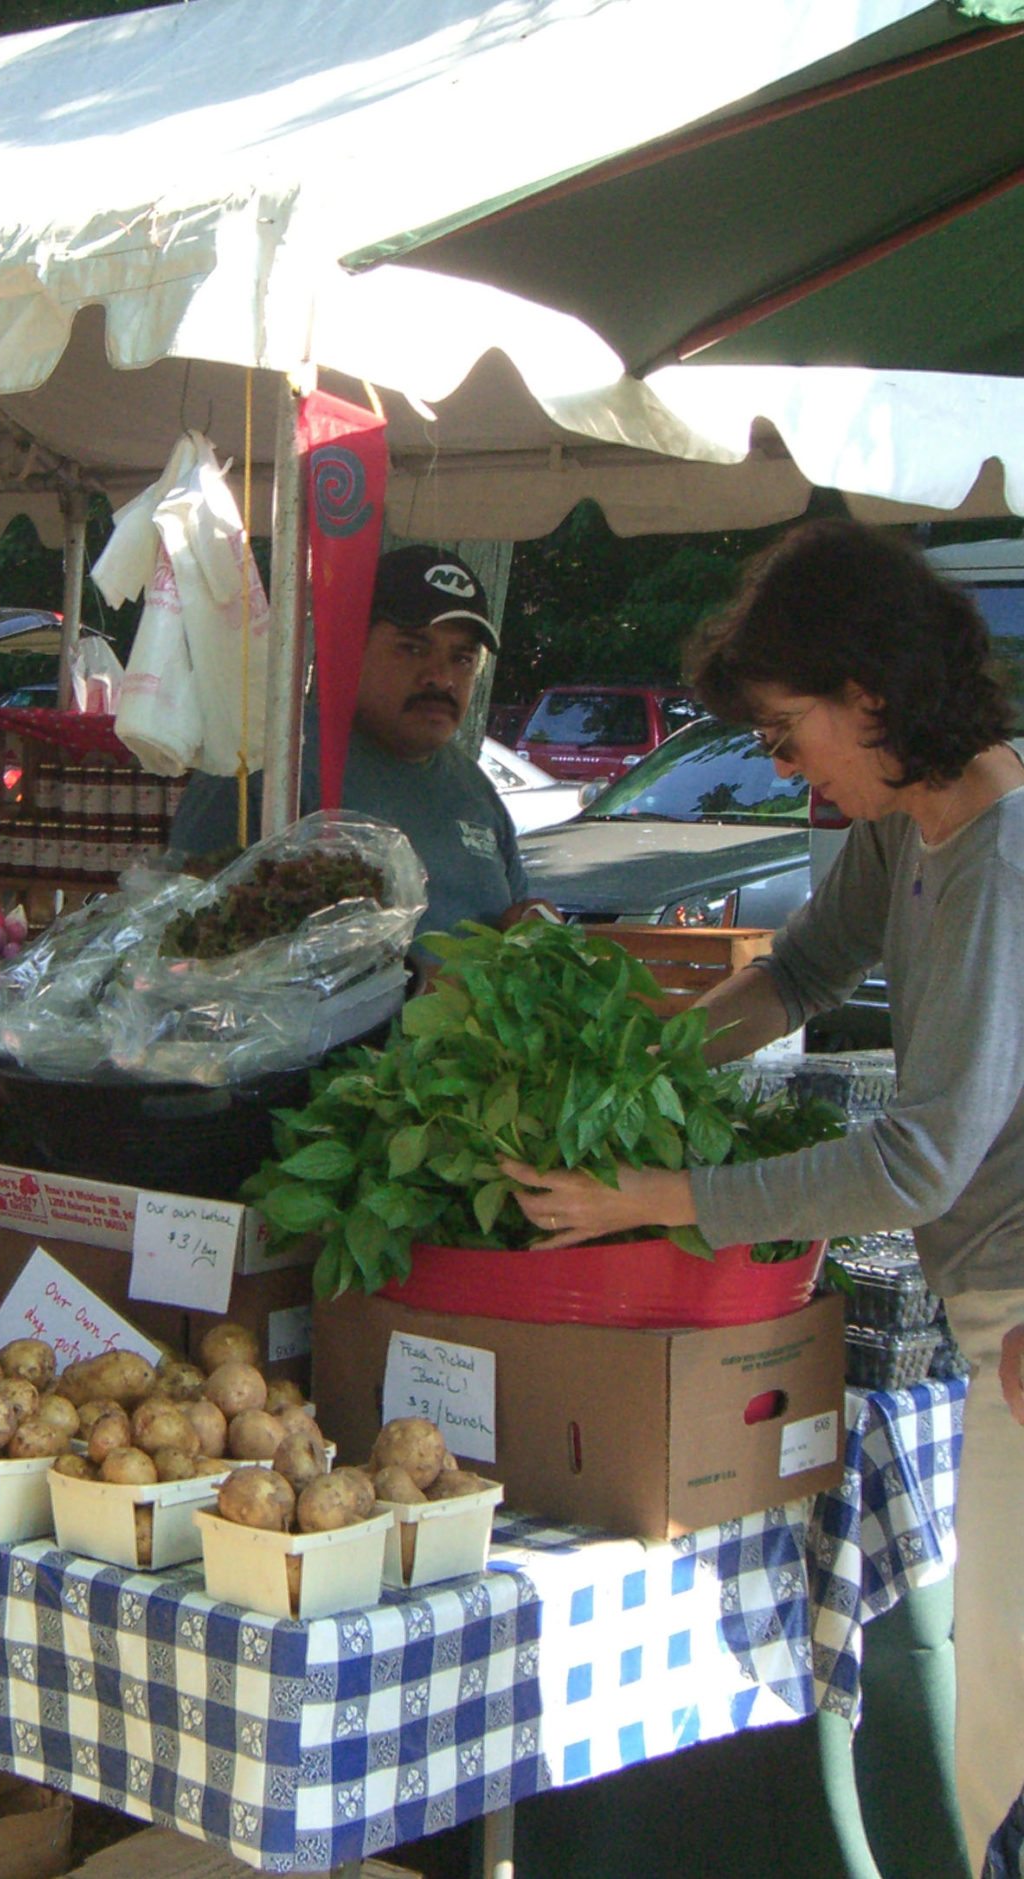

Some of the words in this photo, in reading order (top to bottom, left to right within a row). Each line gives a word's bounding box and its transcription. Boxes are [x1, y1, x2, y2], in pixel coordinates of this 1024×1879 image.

[430, 569, 467, 591] NY
[550, 755, 600, 764] SUBARU
[45, 1281, 72, 1308] Our
